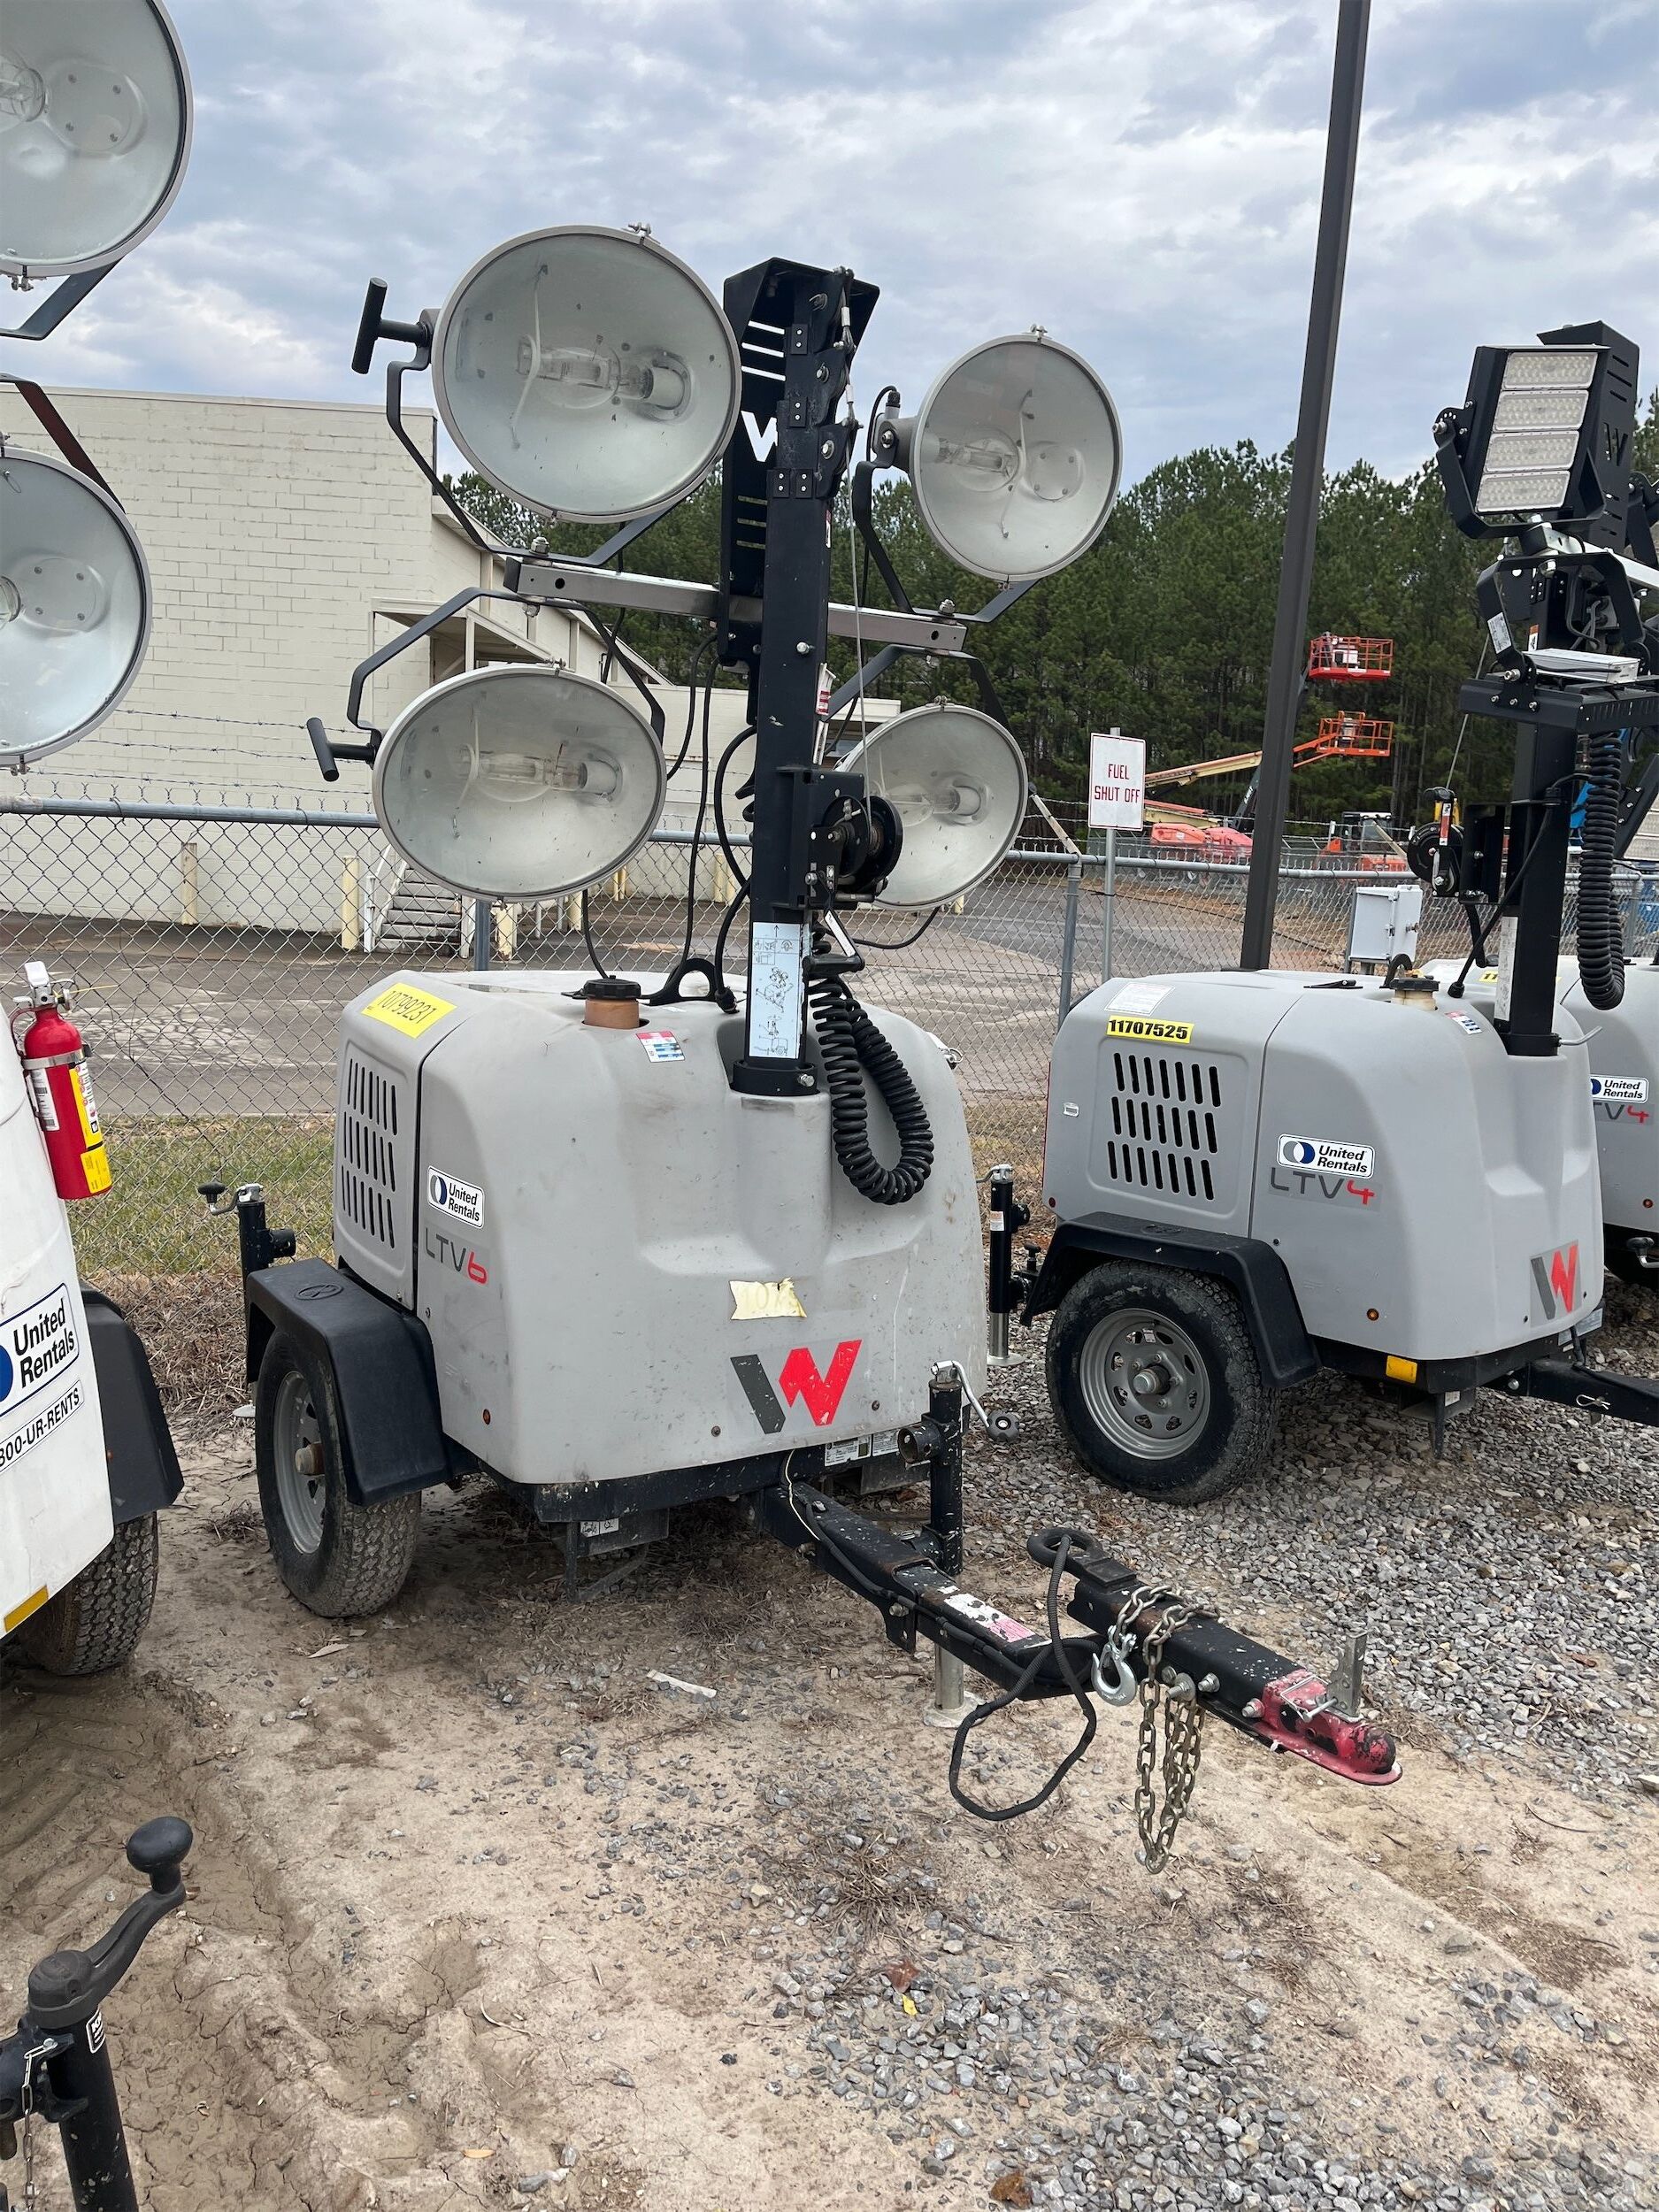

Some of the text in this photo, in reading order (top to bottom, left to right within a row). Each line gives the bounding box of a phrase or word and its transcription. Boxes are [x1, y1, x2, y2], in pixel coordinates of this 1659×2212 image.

[1108, 763, 1129, 780] FUEL
[1094, 785, 1141, 803] SHUT OFF
[377, 990, 437, 1024] 10799231
[1109, 1019, 1188, 1040] 11707525
[1603, 1088, 1643, 1099] Rentals
[1604, 1079, 1641, 1090] United
[1318, 1145, 1365, 1161] United
[1317, 1156, 1368, 1173] Rentals
[449, 1182, 478, 1206] United
[1271, 1167, 1375, 1205] LTV4
[448, 1197, 480, 1222] Rentals
[425, 1226, 488, 1285] LTV6
[13, 1297, 65, 1356] United
[19, 1327, 74, 1388] Rentals
